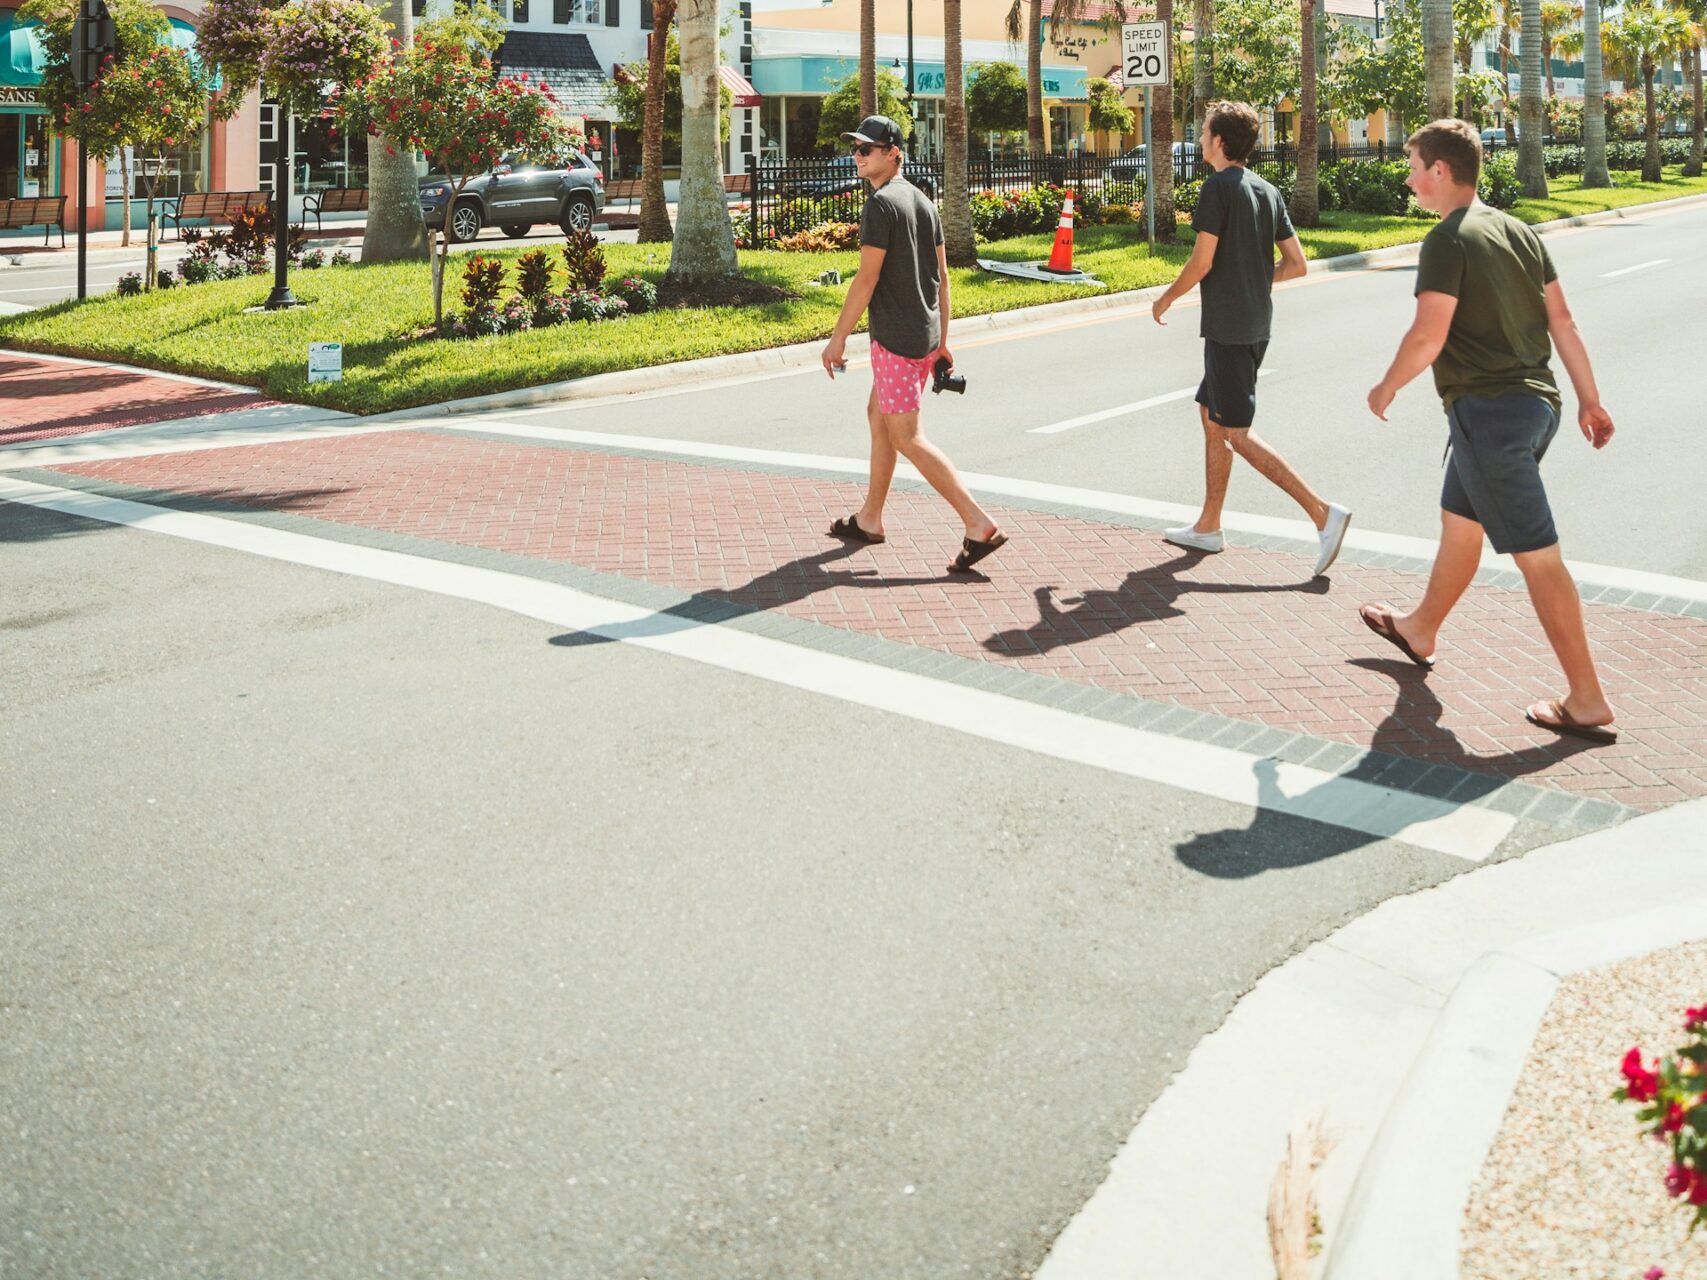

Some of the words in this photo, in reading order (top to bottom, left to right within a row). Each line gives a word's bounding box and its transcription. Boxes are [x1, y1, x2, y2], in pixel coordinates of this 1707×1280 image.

[1125, 29, 1161, 40] SPEED
[1129, 42, 1157, 53] LIMIT
[1127, 55, 1160, 78] 20
